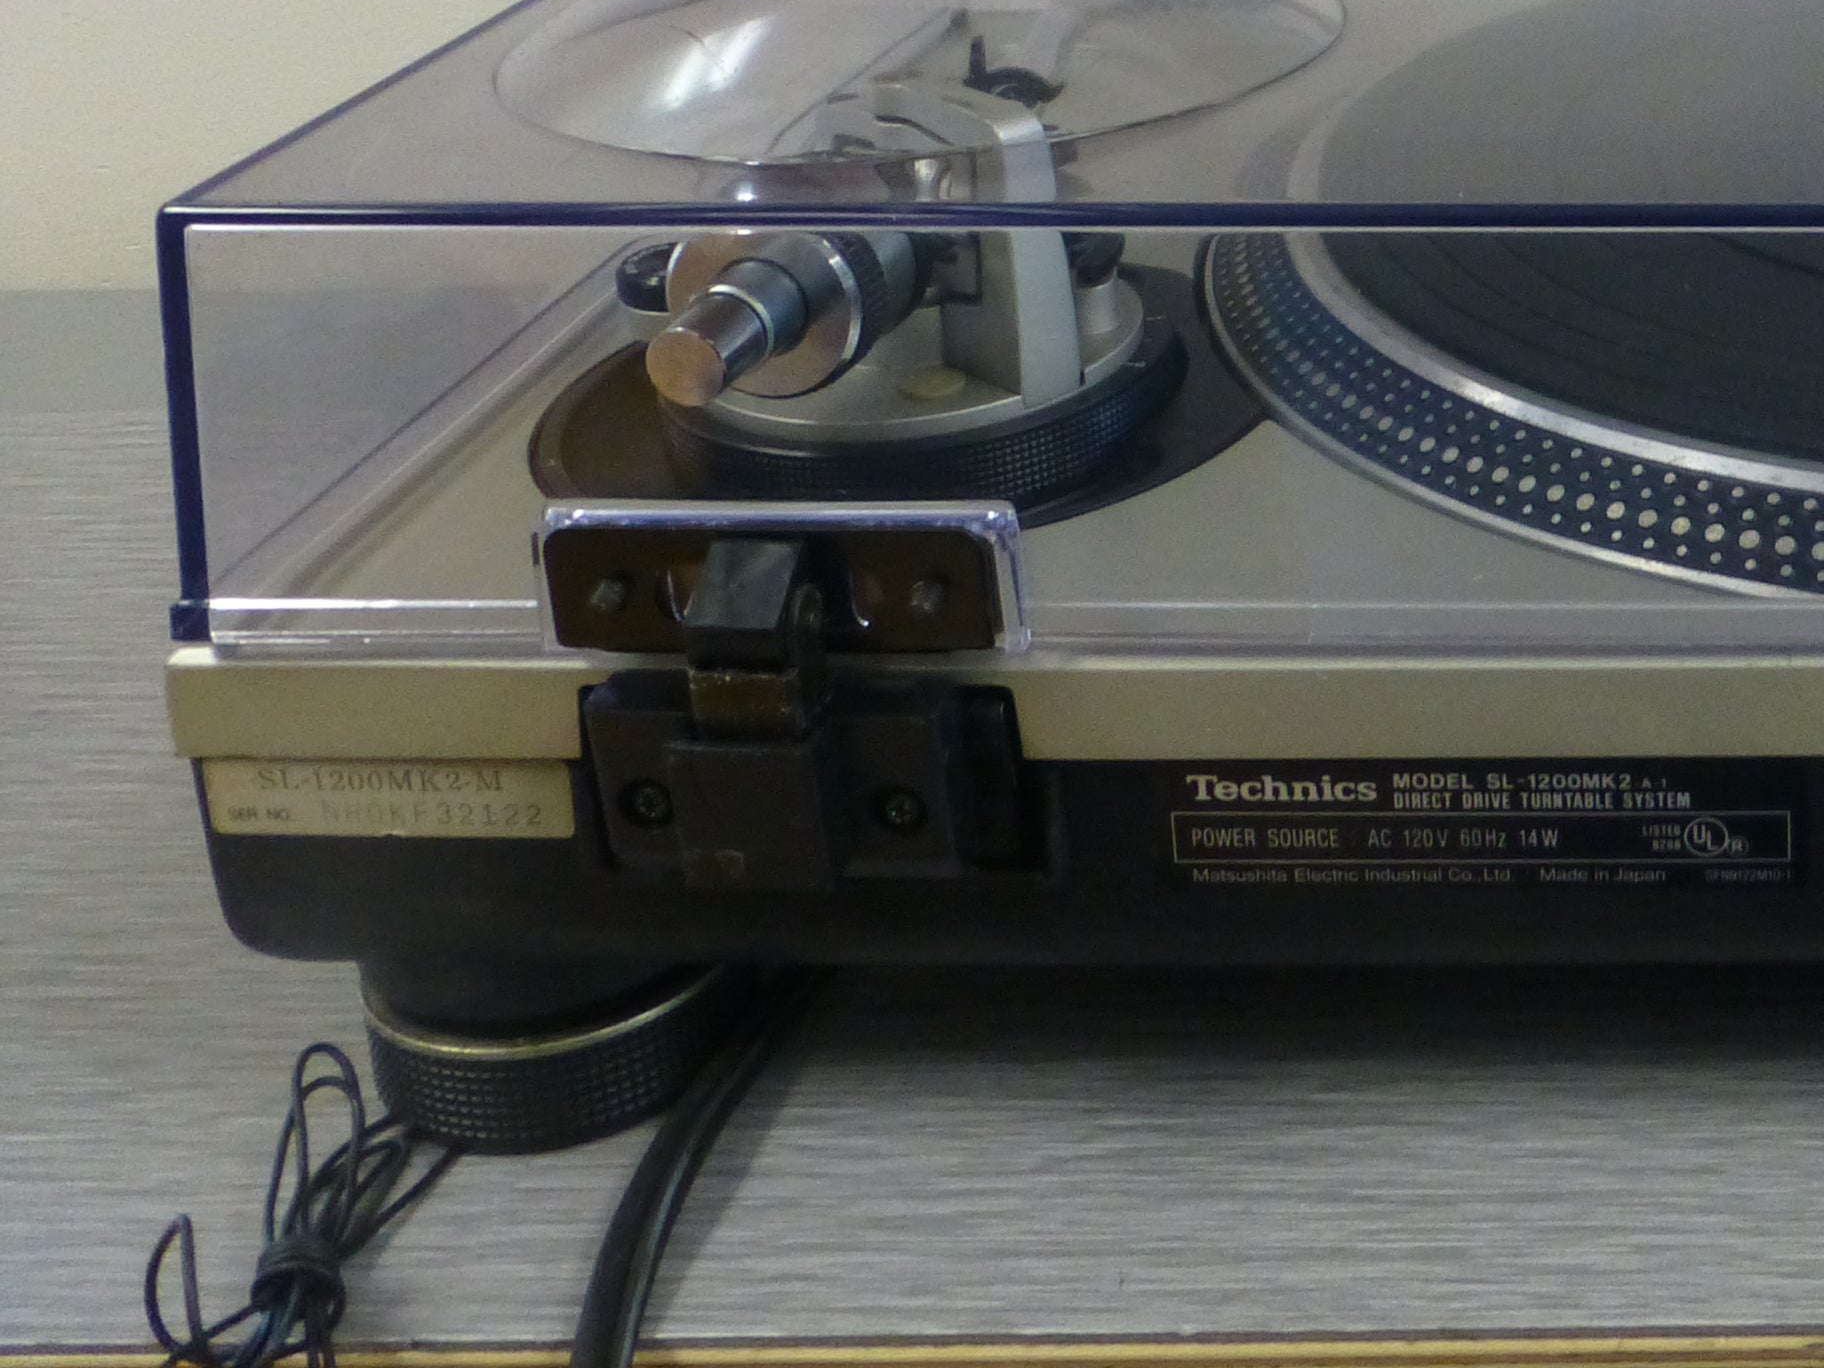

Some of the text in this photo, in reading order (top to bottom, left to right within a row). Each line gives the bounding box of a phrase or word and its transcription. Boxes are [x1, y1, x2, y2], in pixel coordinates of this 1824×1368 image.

[1186, 773, 1378, 803] Technics
[1392, 773, 1474, 790] MODEL
[1486, 772, 1632, 790] SL-1200MK2
[1393, 791, 1691, 810] DIRECT DRIVE TURNTABLE SYSTEM
[1191, 828, 1256, 850] POWER
[1267, 828, 1340, 850] SOURCE
[1368, 828, 1393, 849] AC
[1193, 867, 1287, 883] Matsushita
[1294, 867, 1359, 883] Electric
[1365, 867, 1442, 883] Industrial
[1540, 867, 1666, 886] Made in Japan
